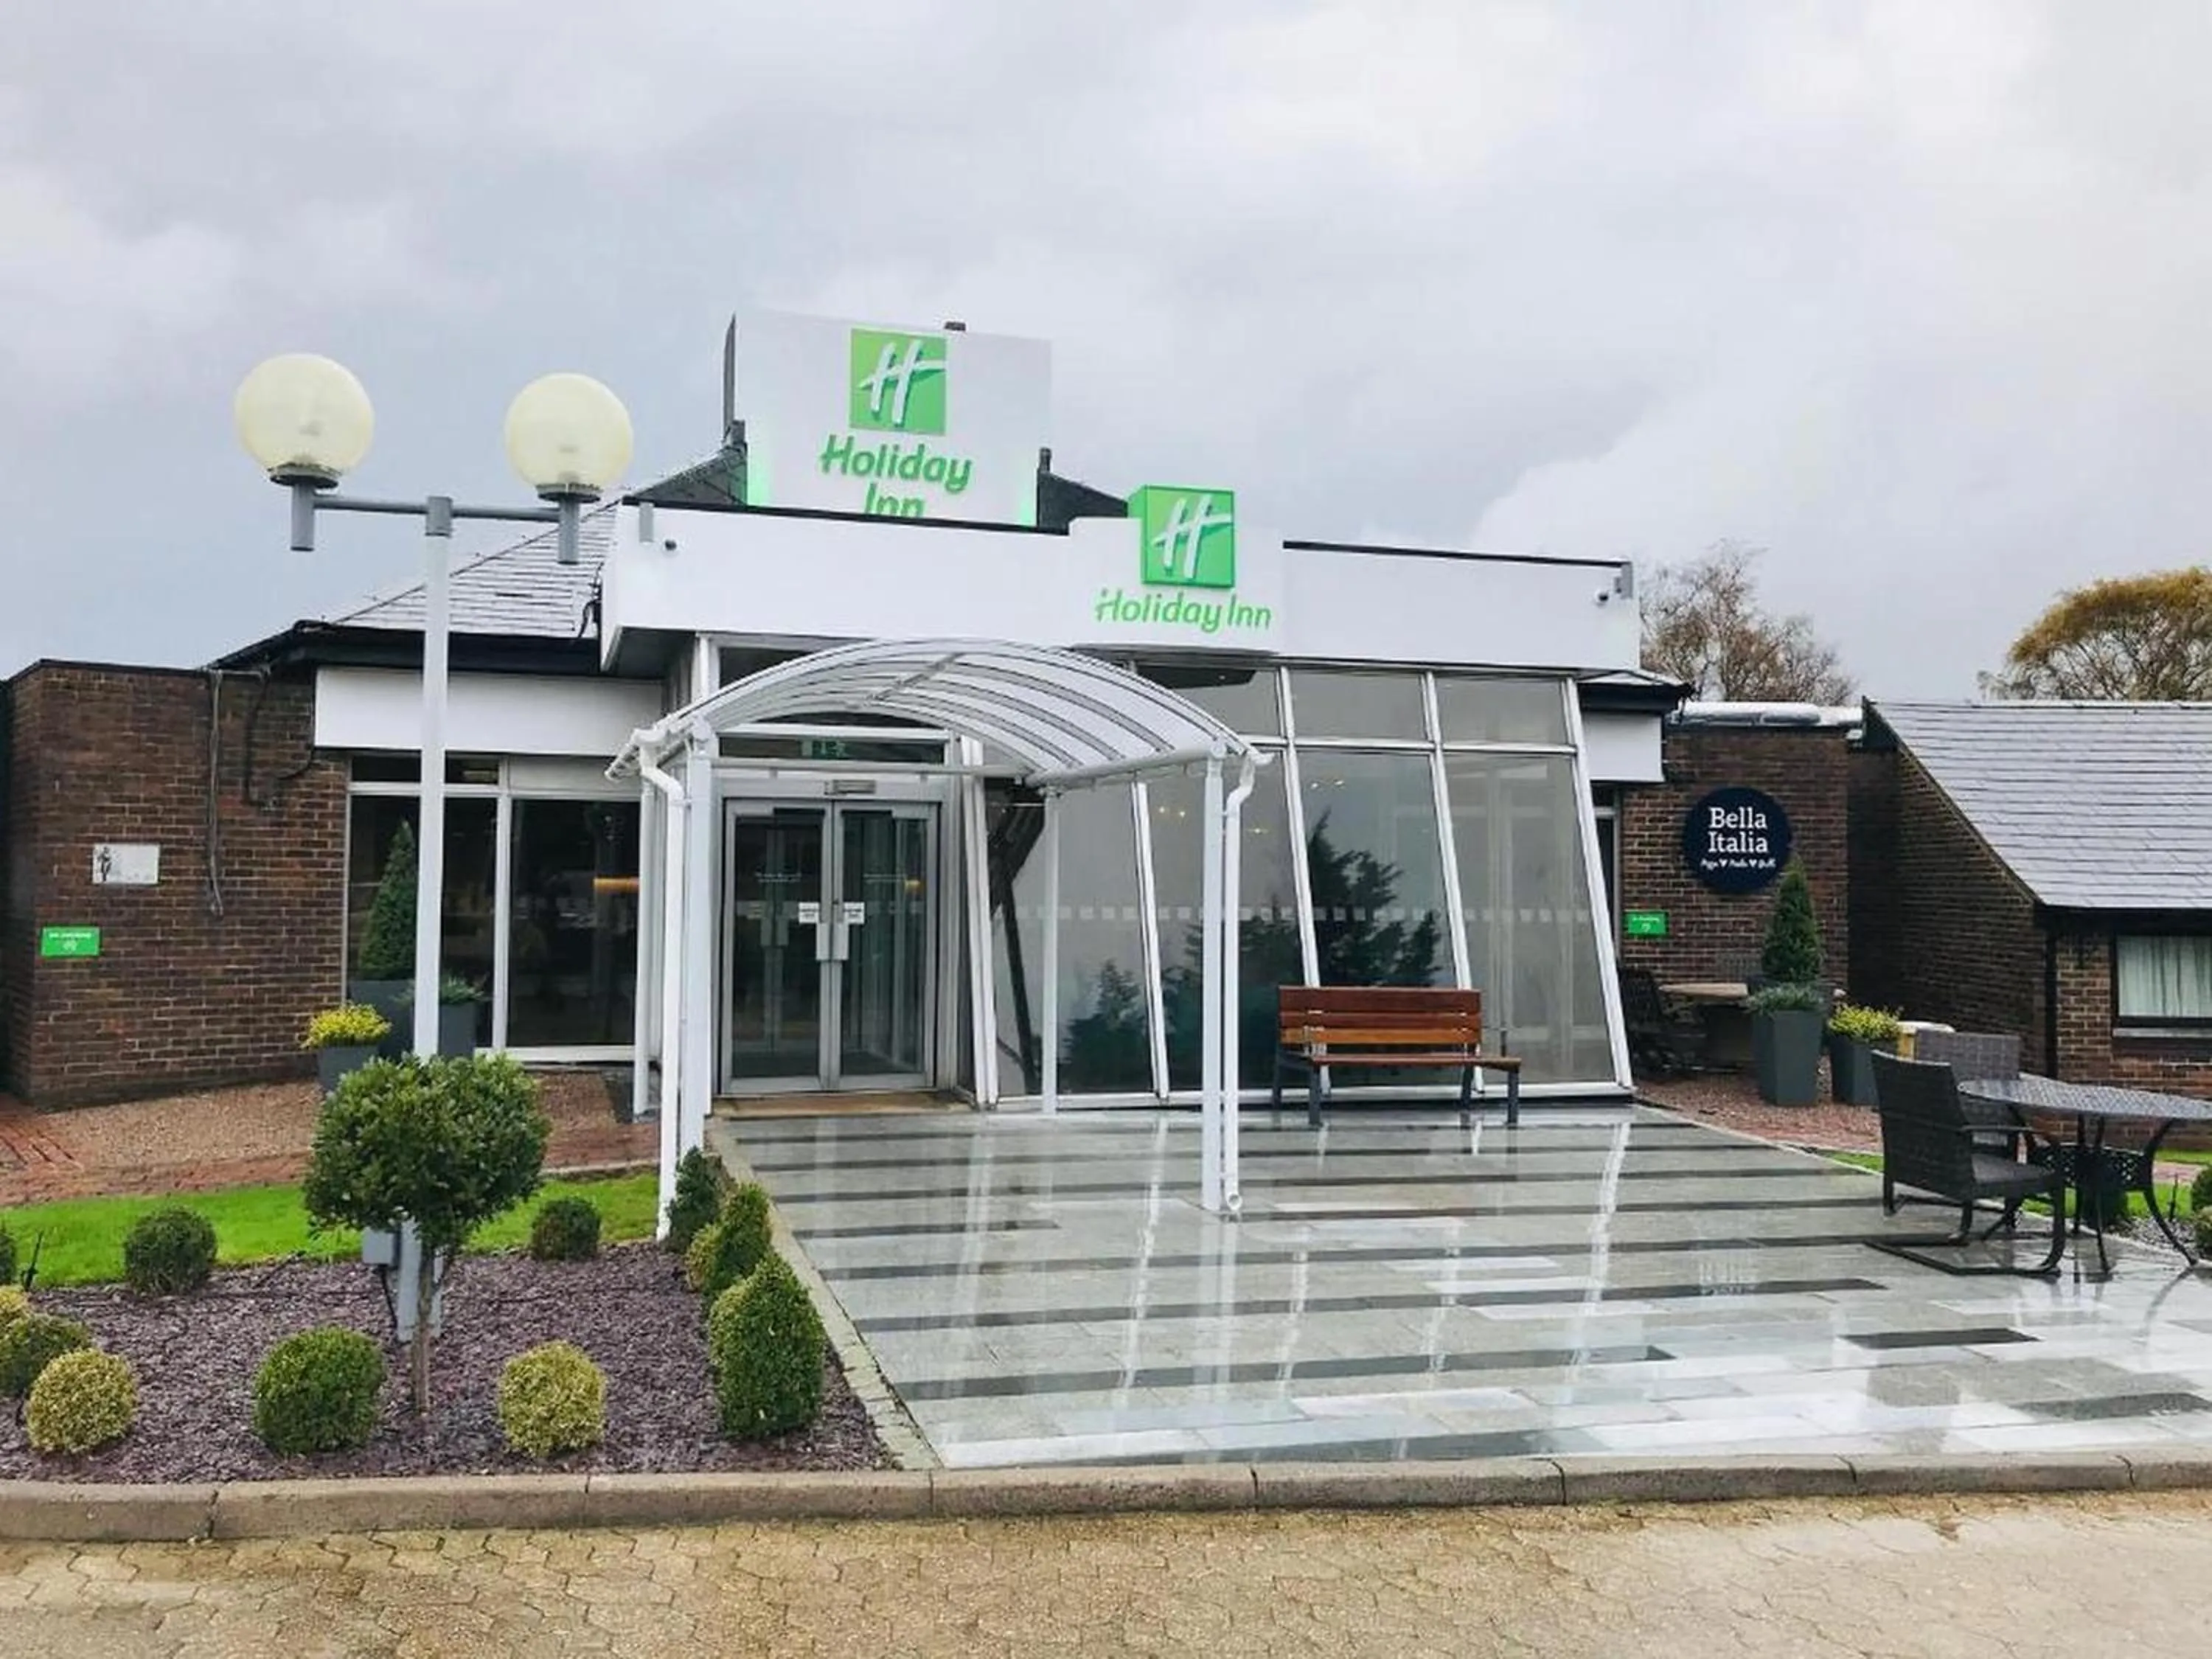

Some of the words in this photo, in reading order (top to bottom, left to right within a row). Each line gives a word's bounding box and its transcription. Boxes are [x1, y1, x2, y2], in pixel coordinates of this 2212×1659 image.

[821, 434, 973, 493] Holiday
[865, 483, 925, 517] Inn
[1095, 589, 1222, 633] Holiday
[1227, 593, 1272, 629] Inn
[1708, 806, 1768, 829] Bella
[1708, 831, 1769, 853] Italia
